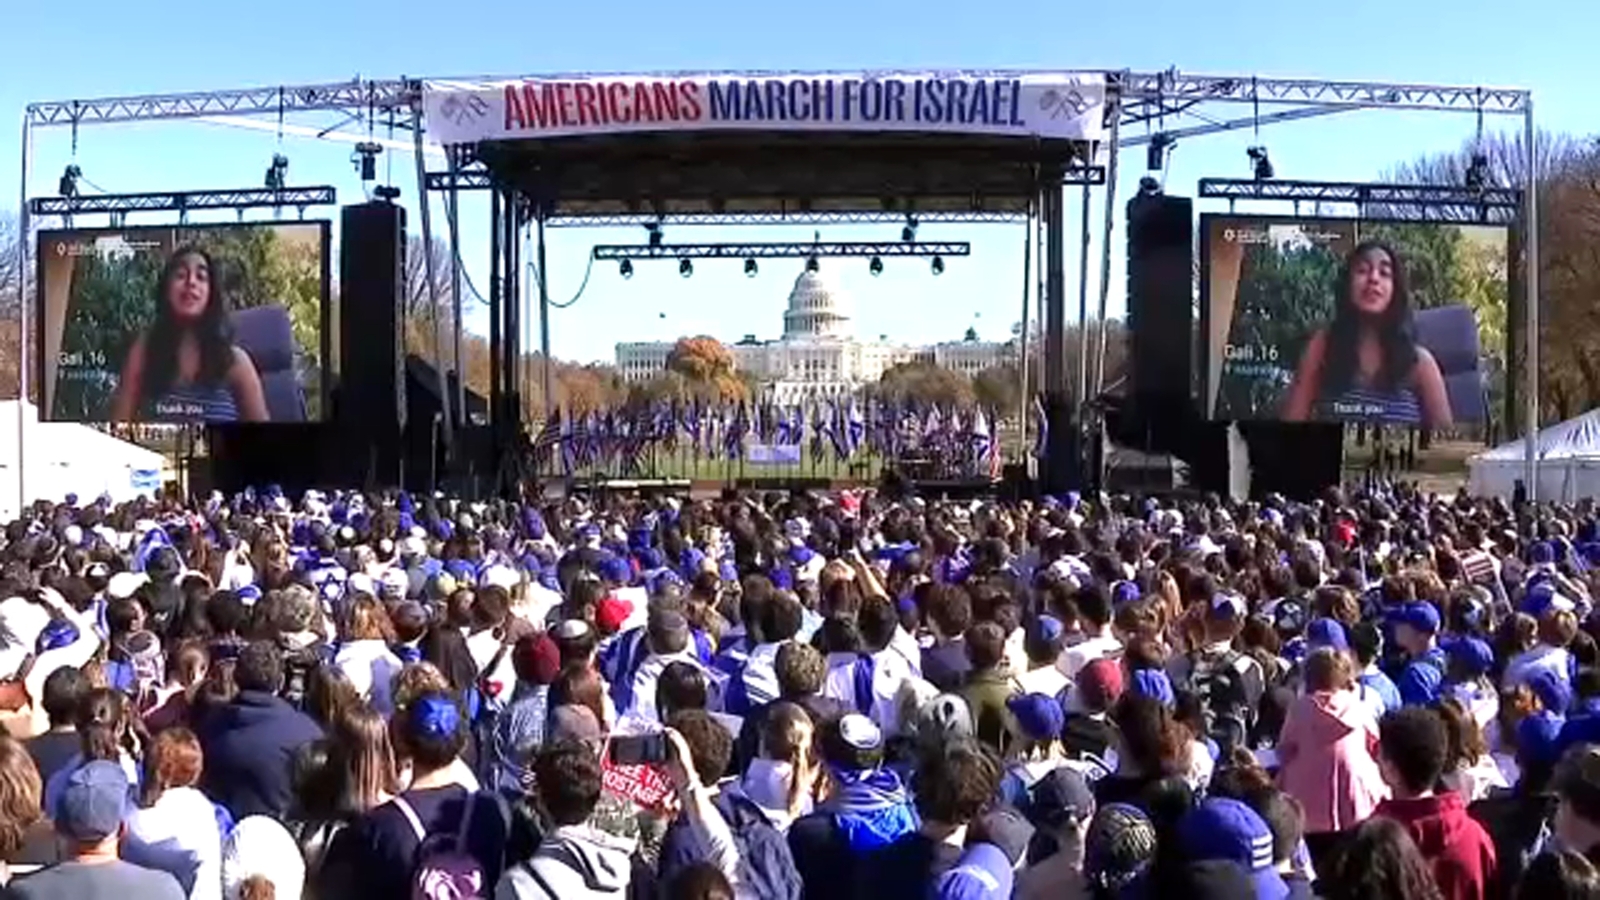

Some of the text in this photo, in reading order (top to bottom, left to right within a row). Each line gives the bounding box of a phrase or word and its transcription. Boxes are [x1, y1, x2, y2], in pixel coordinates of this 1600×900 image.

[504, 79, 1026, 131] AMERICANS MARCH FOR ISRAEL
